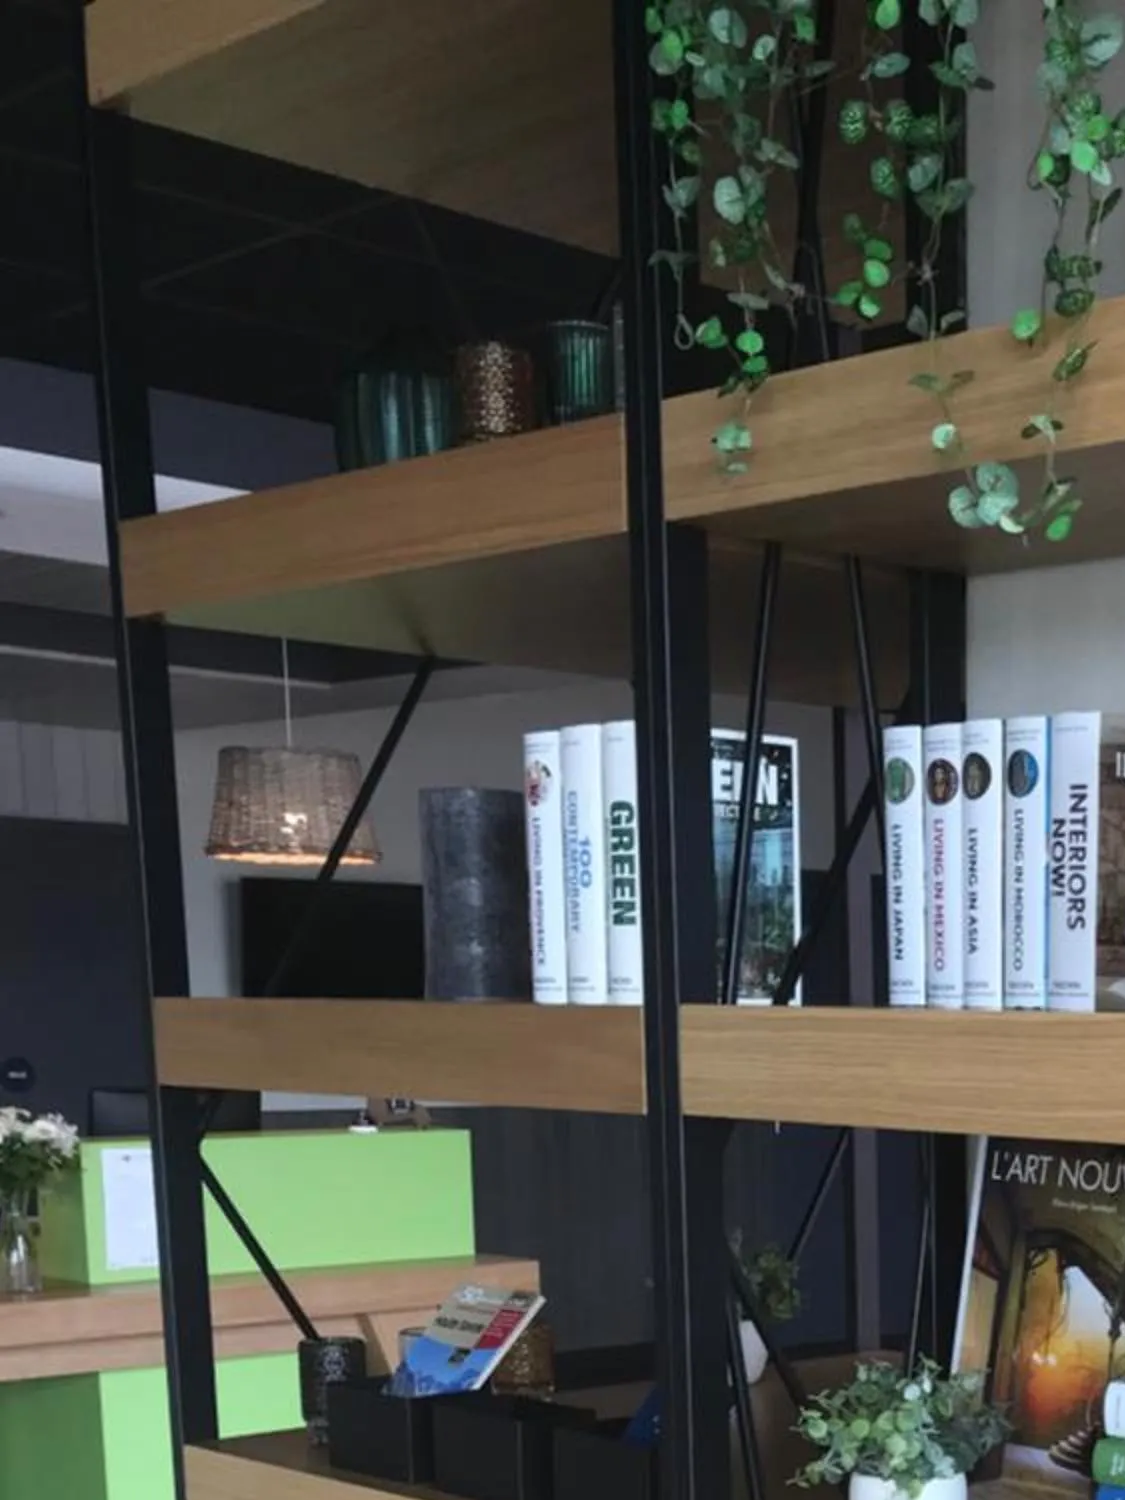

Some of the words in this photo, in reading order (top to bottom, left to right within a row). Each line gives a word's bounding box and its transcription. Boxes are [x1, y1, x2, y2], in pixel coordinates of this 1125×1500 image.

[579, 836, 592, 888] 100
[892, 824, 903, 882] LIVING
[933, 819, 944, 878] LIVING
[967, 828, 978, 887] LIVING
[1014, 809, 1024, 861] LIVING
[1051, 817, 1066, 897] NOW!
[1067, 784, 1088, 931] INTERIORS
[609, 800, 636, 926] GREEN
[1014, 864, 1024, 884] IN
[893, 886, 903, 905] IN
[933, 883, 944, 898] IN
[967, 892, 978, 910] IN
[893, 907, 904, 961] JAPAN
[932, 902, 945, 972] MEXICO
[967, 915, 978, 955] ASIA
[1012, 888, 1025, 972] MOROCCO
[991, 1151, 1053, 1185] L'ART
